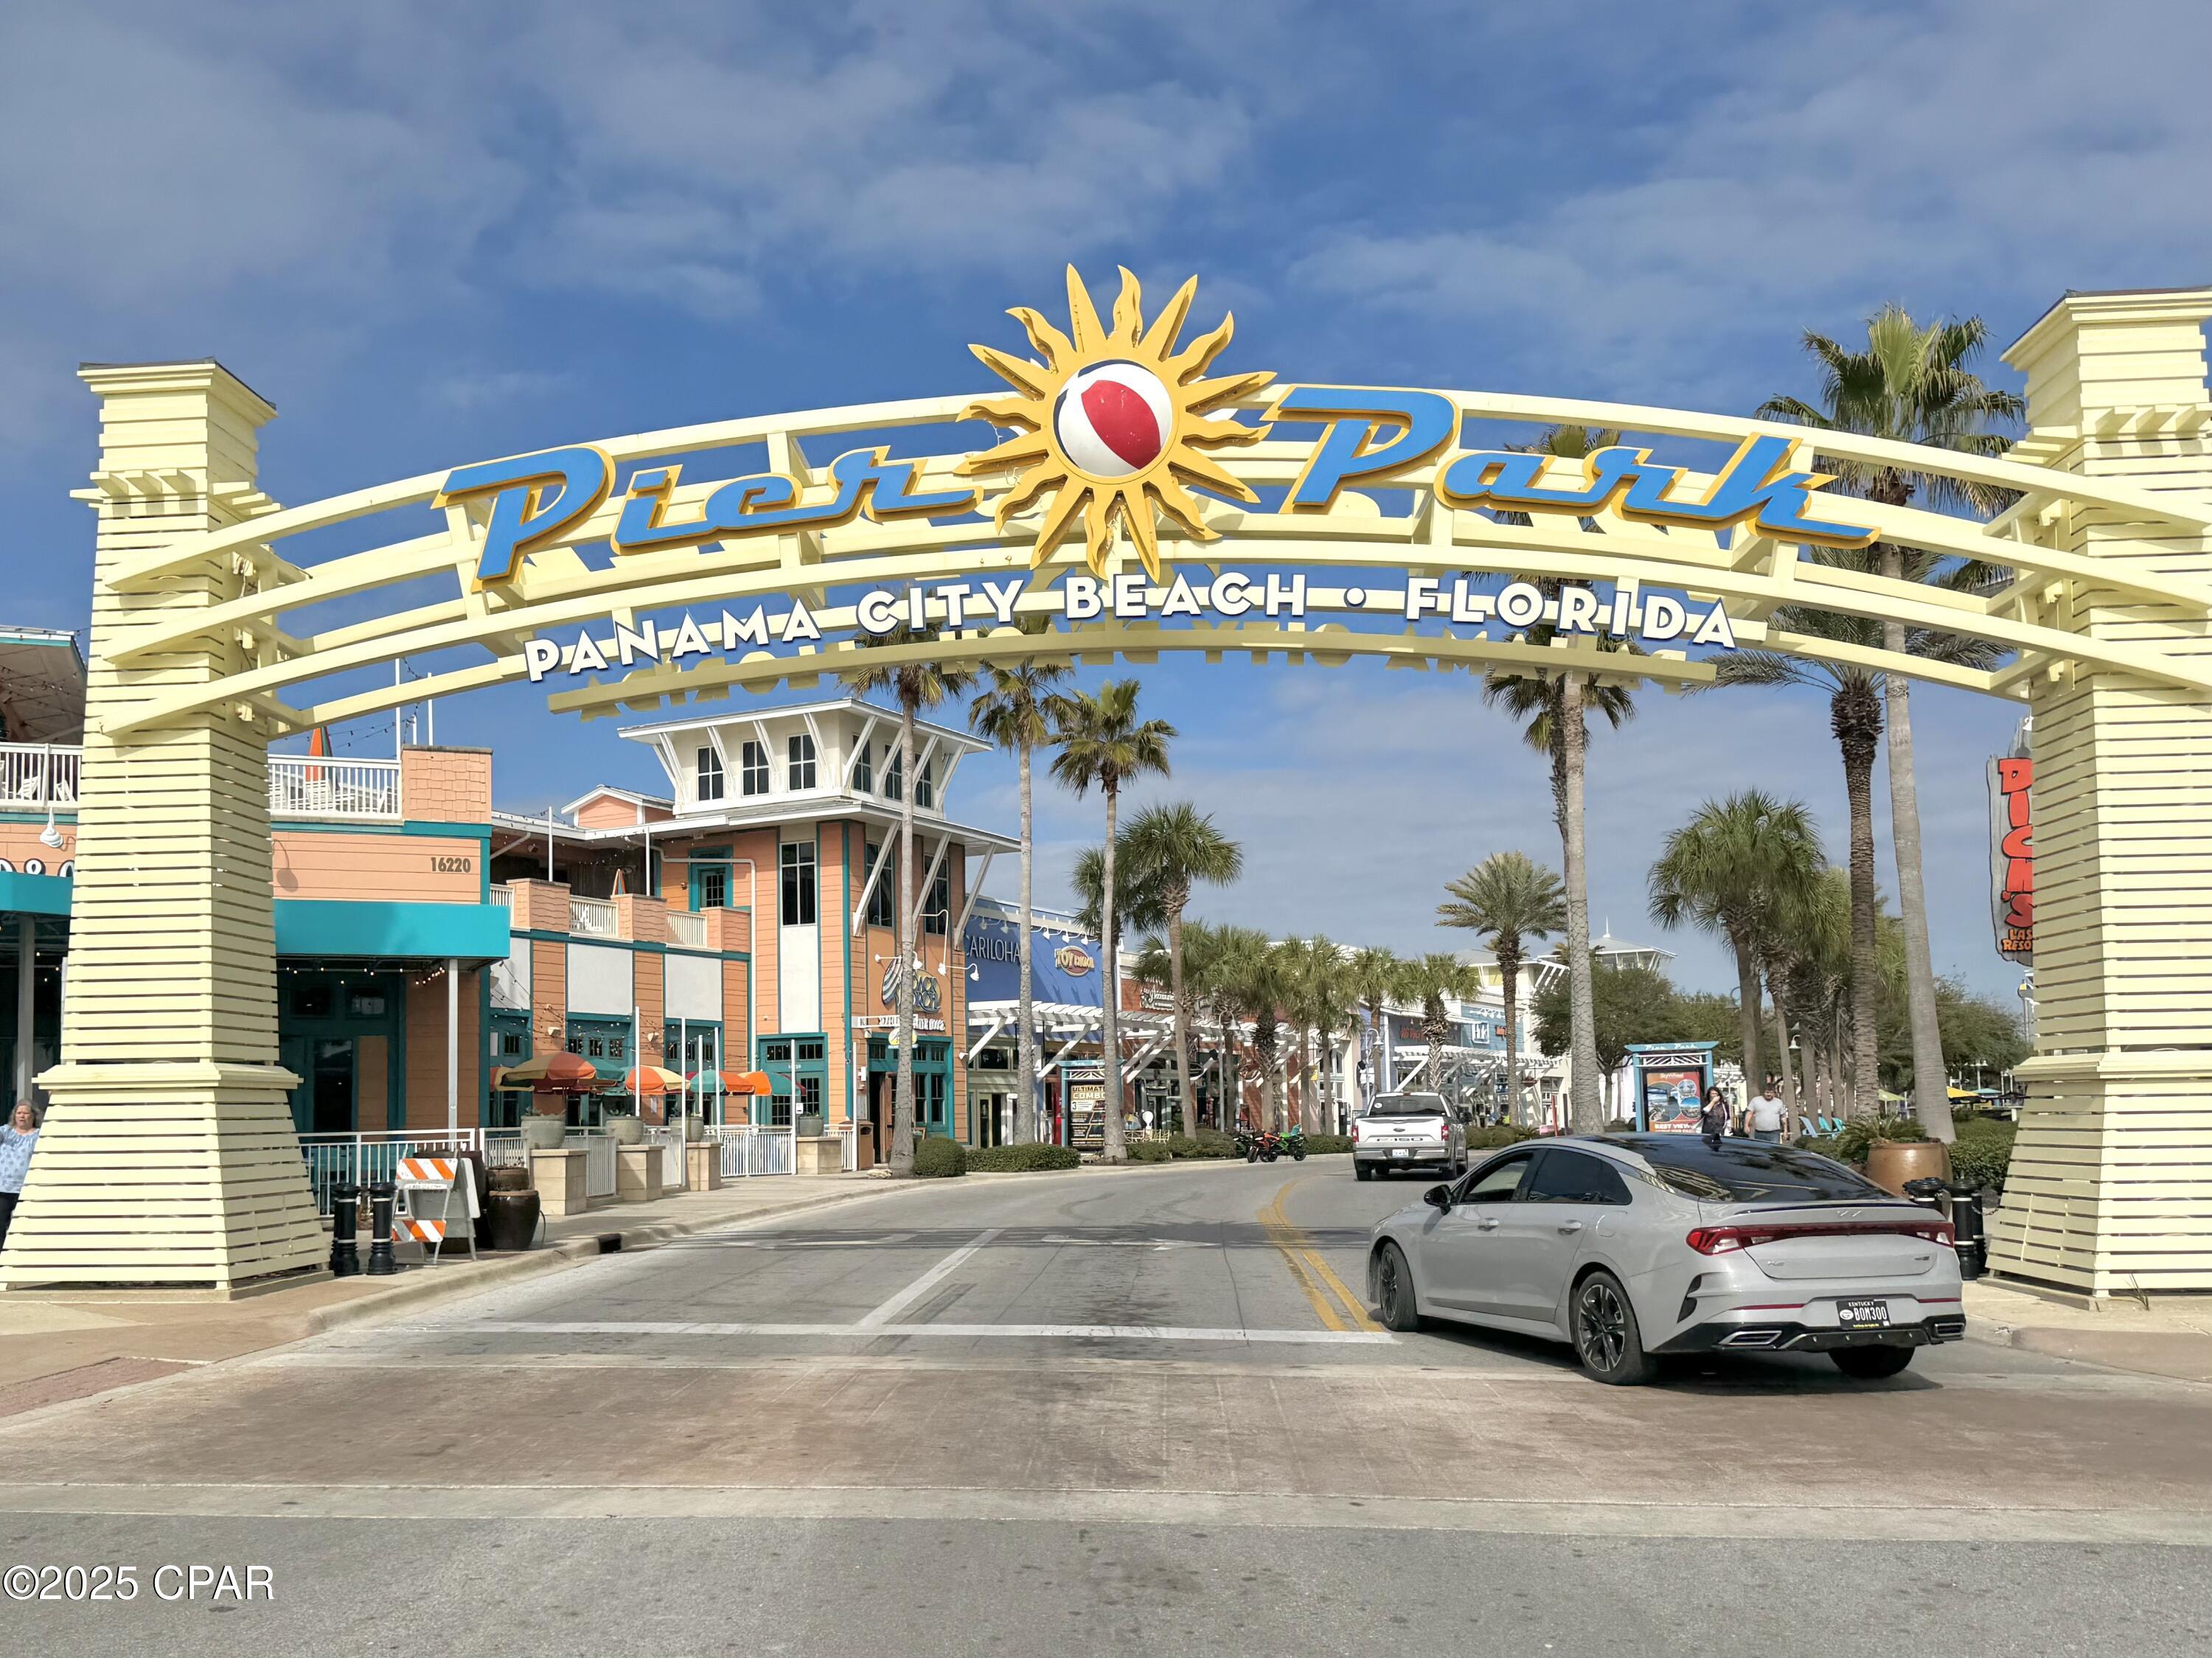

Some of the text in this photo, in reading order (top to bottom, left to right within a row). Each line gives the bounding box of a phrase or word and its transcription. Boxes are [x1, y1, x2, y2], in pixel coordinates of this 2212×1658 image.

[434, 384, 1881, 591] Pier Park
[523, 571, 1737, 683] PANAMA CITY BEACH FLORIDA
[431, 857, 471, 873] 16220
[2002, 938, 2033, 951] RESO
[2009, 928, 2033, 940] LAS
[967, 935, 1021, 964] ARILOHA
